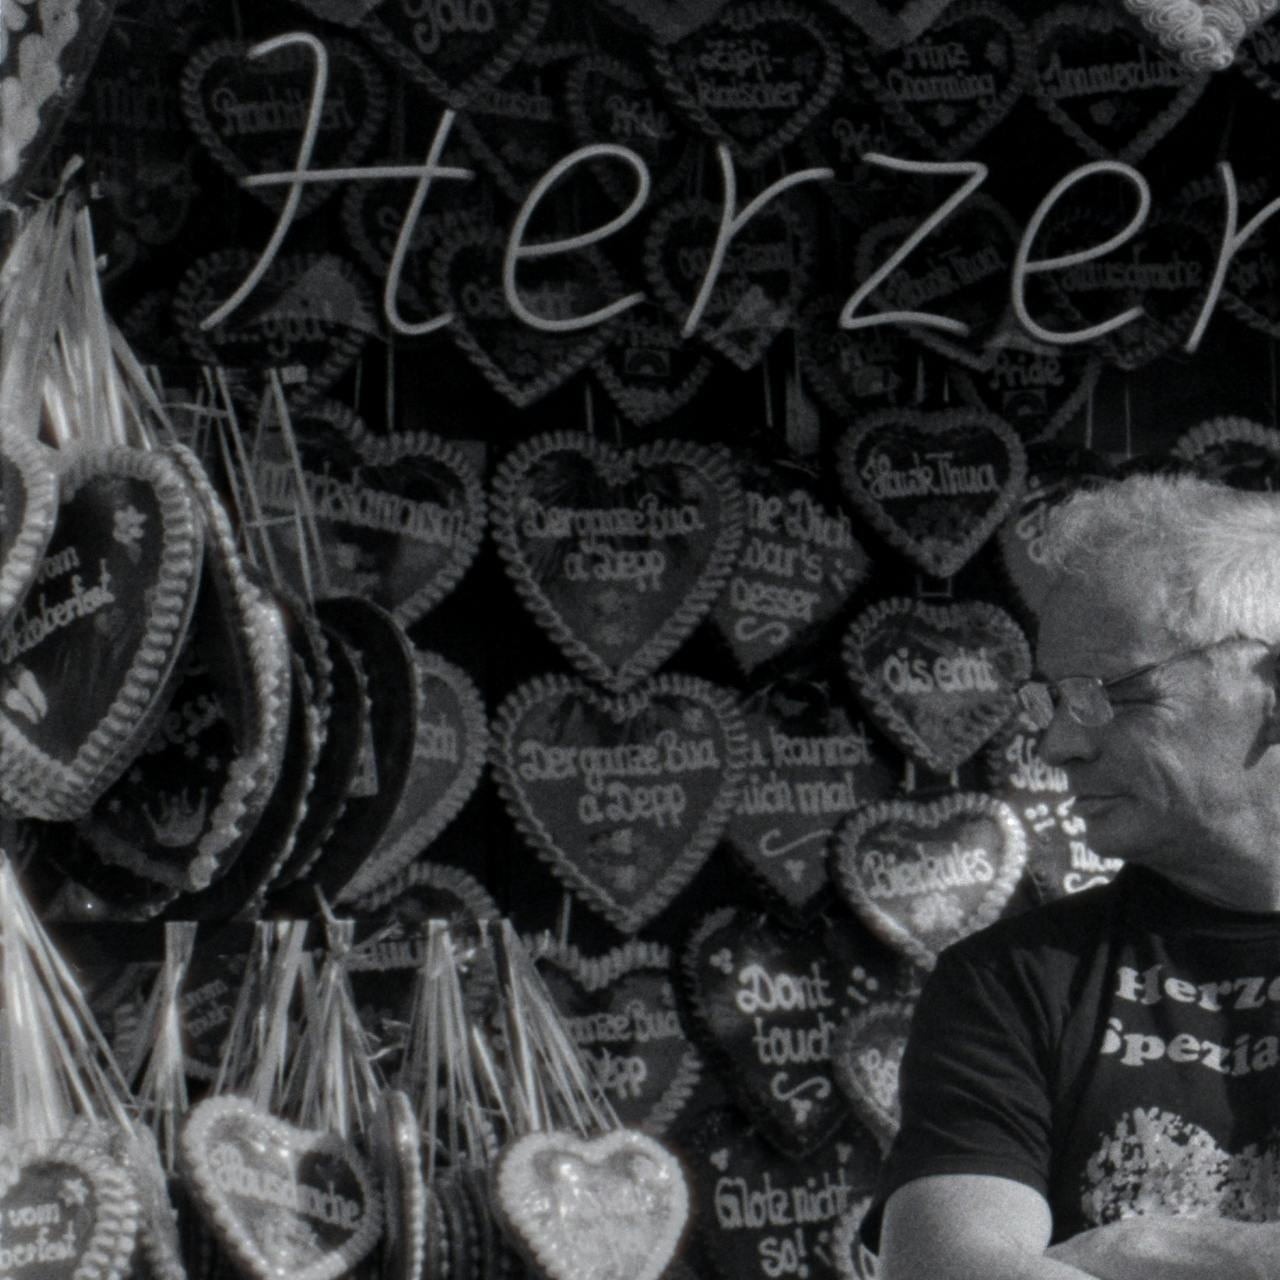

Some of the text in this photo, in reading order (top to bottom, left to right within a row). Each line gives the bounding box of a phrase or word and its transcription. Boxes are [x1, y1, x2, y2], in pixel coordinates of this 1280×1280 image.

[517, 737, 578, 781] Der
[655, 730, 720, 776] Bua
[606, 781, 687, 827] Depp
